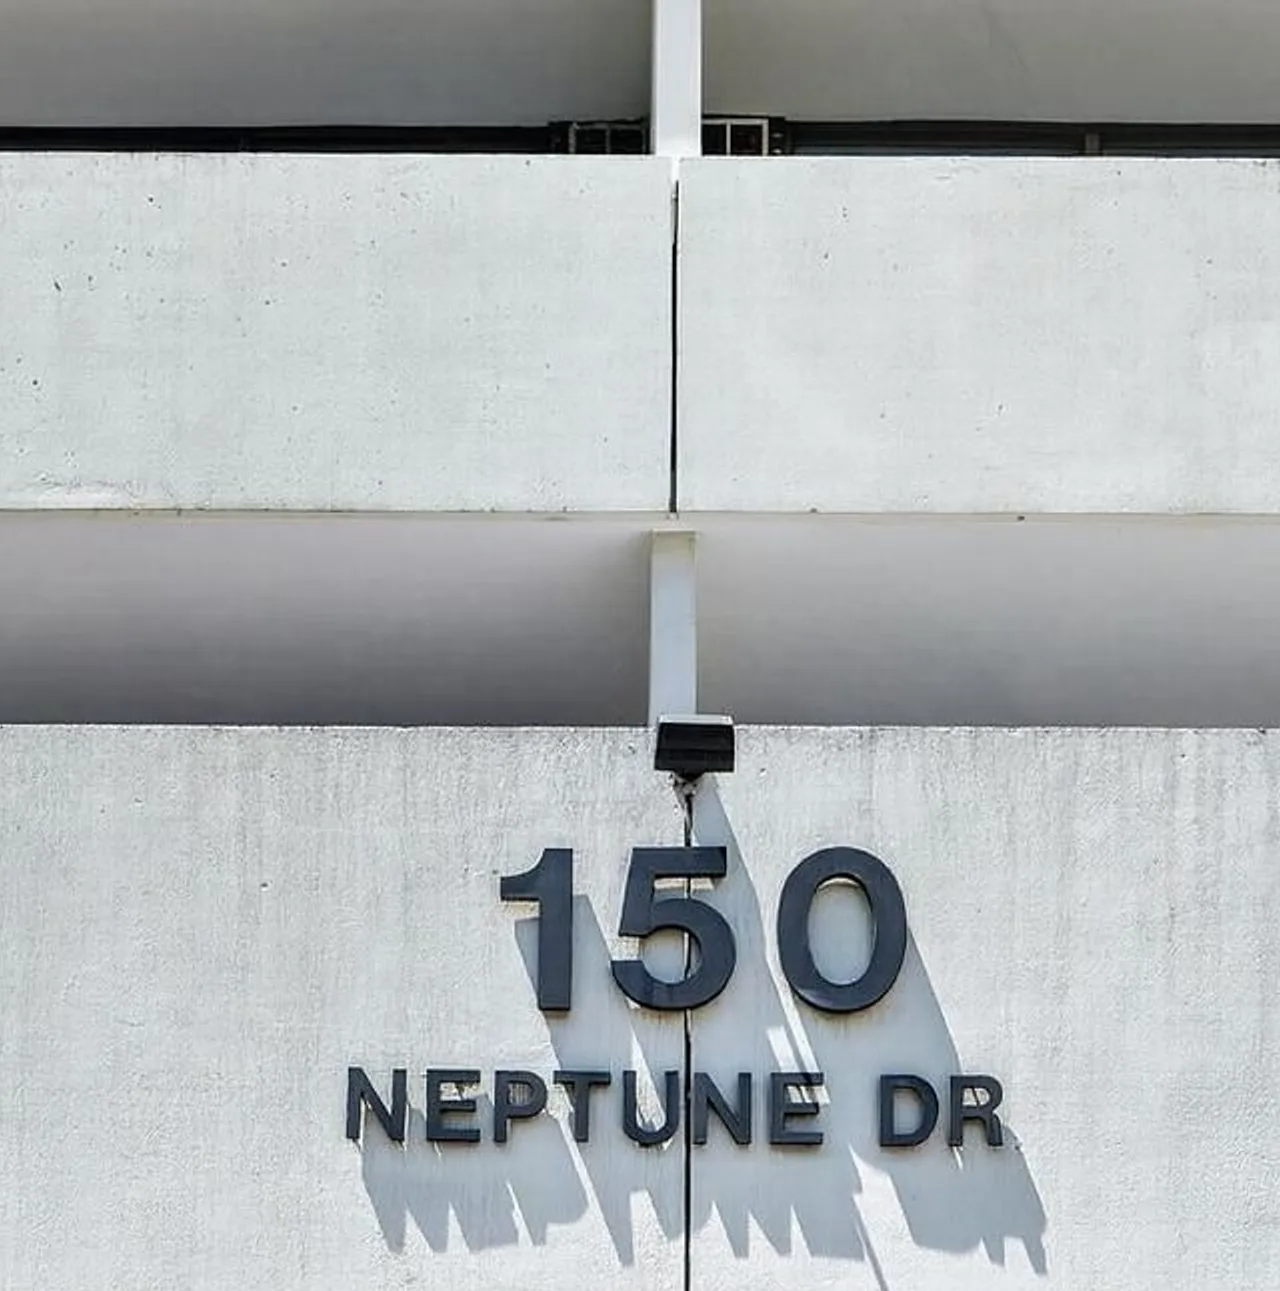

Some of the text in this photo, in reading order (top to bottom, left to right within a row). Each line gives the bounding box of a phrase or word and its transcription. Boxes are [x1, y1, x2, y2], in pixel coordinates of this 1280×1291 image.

[499, 845, 908, 1014] 150
[345, 1066, 1005, 1148] NEPTUNE DR
